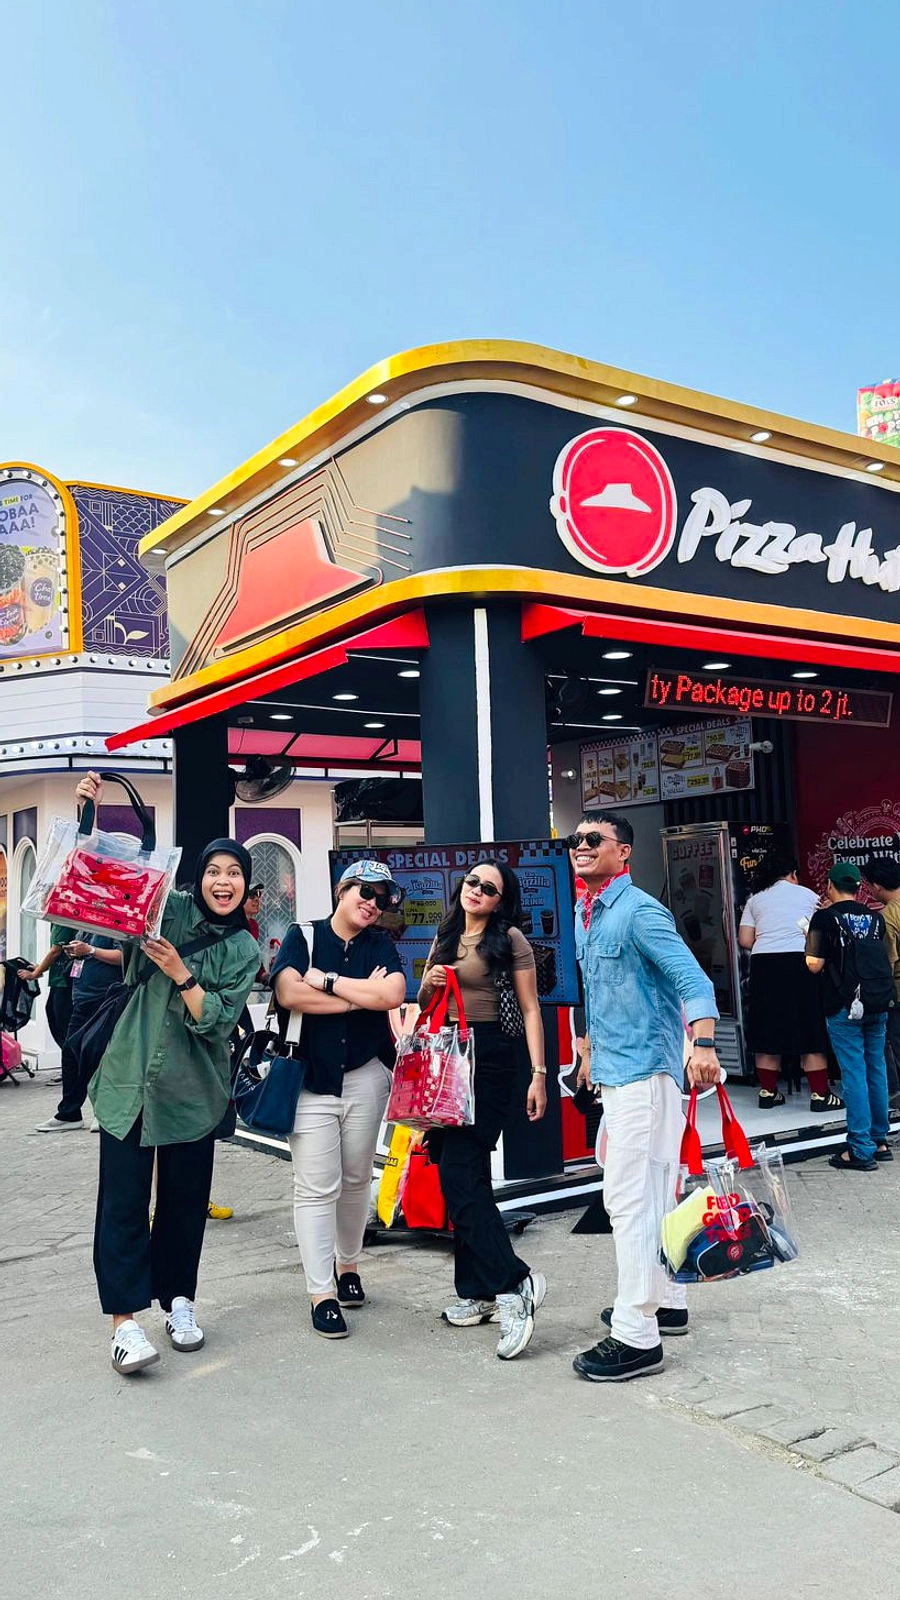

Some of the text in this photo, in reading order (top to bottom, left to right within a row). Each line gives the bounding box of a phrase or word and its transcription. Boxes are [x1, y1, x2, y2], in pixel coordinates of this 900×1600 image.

[4, 496, 19, 505] TIME
[20, 493, 33, 502] FOR
[677, 487, 900, 593] Pizza Hut
[676, 675, 763, 712] Package
[768, 691, 791, 714] up
[797, 690, 815, 711] to
[820, 690, 832, 714] 2
[676, 717, 731, 734] SPECIAL DEALS
[827, 835, 894, 850] Celebrate
[386, 852, 450, 869] SPECIAL
[456, 848, 509, 868] DEALS
[518, 877, 551, 889] igzilla
